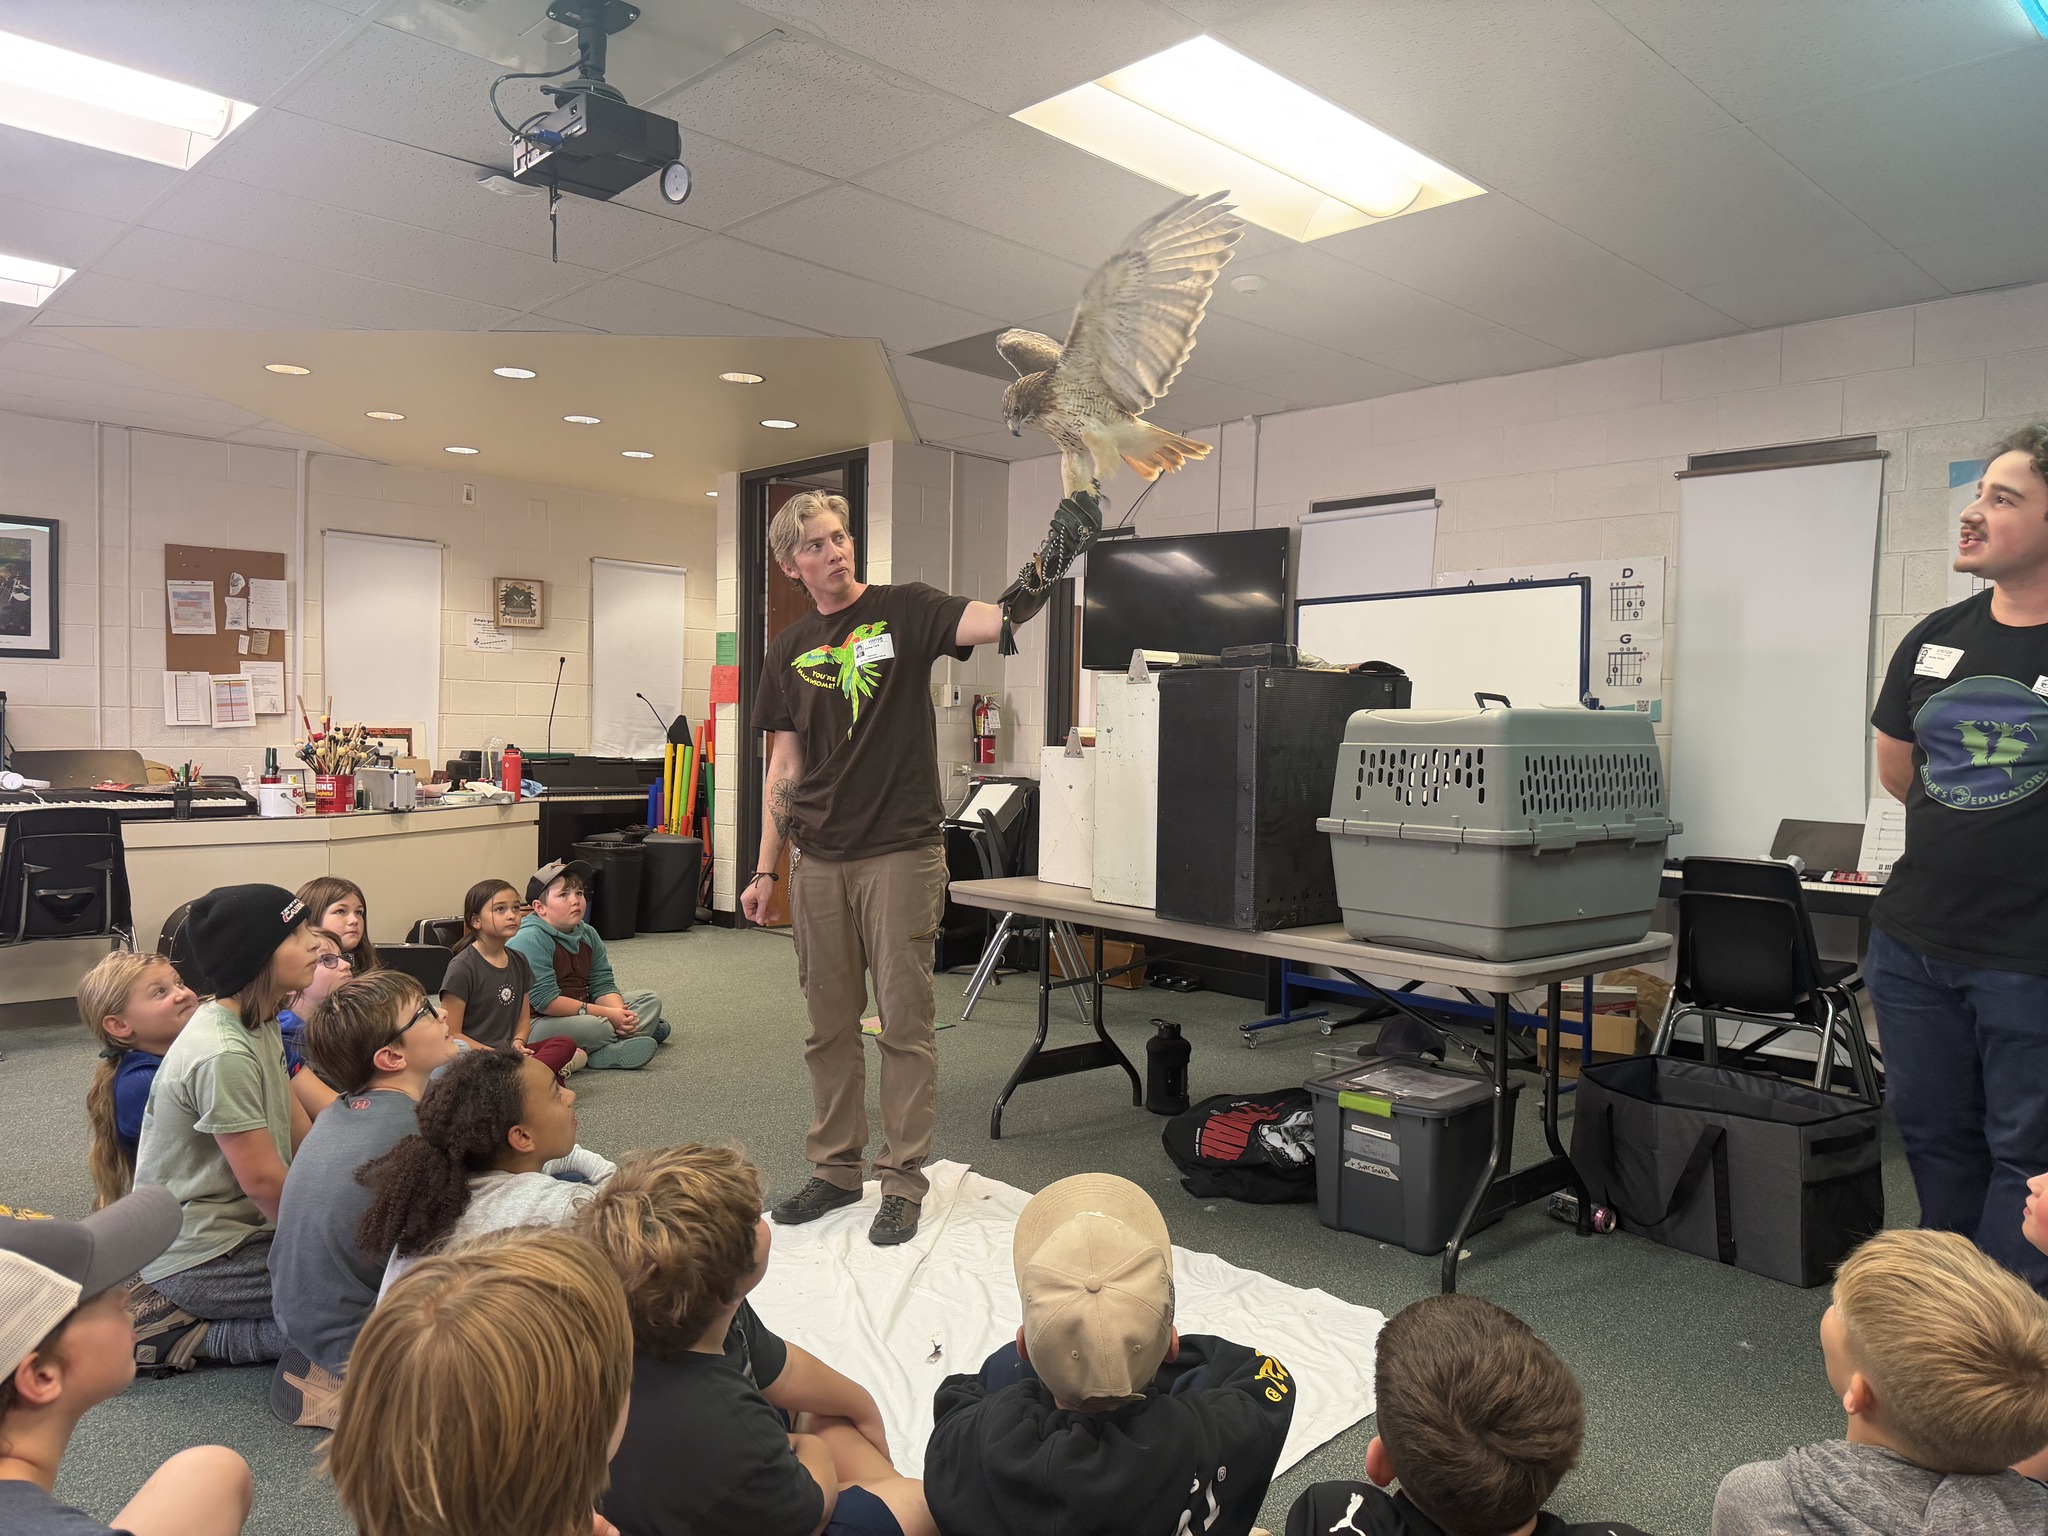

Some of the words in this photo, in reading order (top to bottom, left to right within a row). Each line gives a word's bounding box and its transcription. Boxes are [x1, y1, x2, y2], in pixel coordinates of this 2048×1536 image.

[1621, 567, 1634, 579] D
[1620, 634, 1632, 644] G
[797, 668, 836, 690] MACAWSOME!
[812, 670, 836, 683] YOU'RE
[1970, 770, 2047, 805] EDUCATORS
